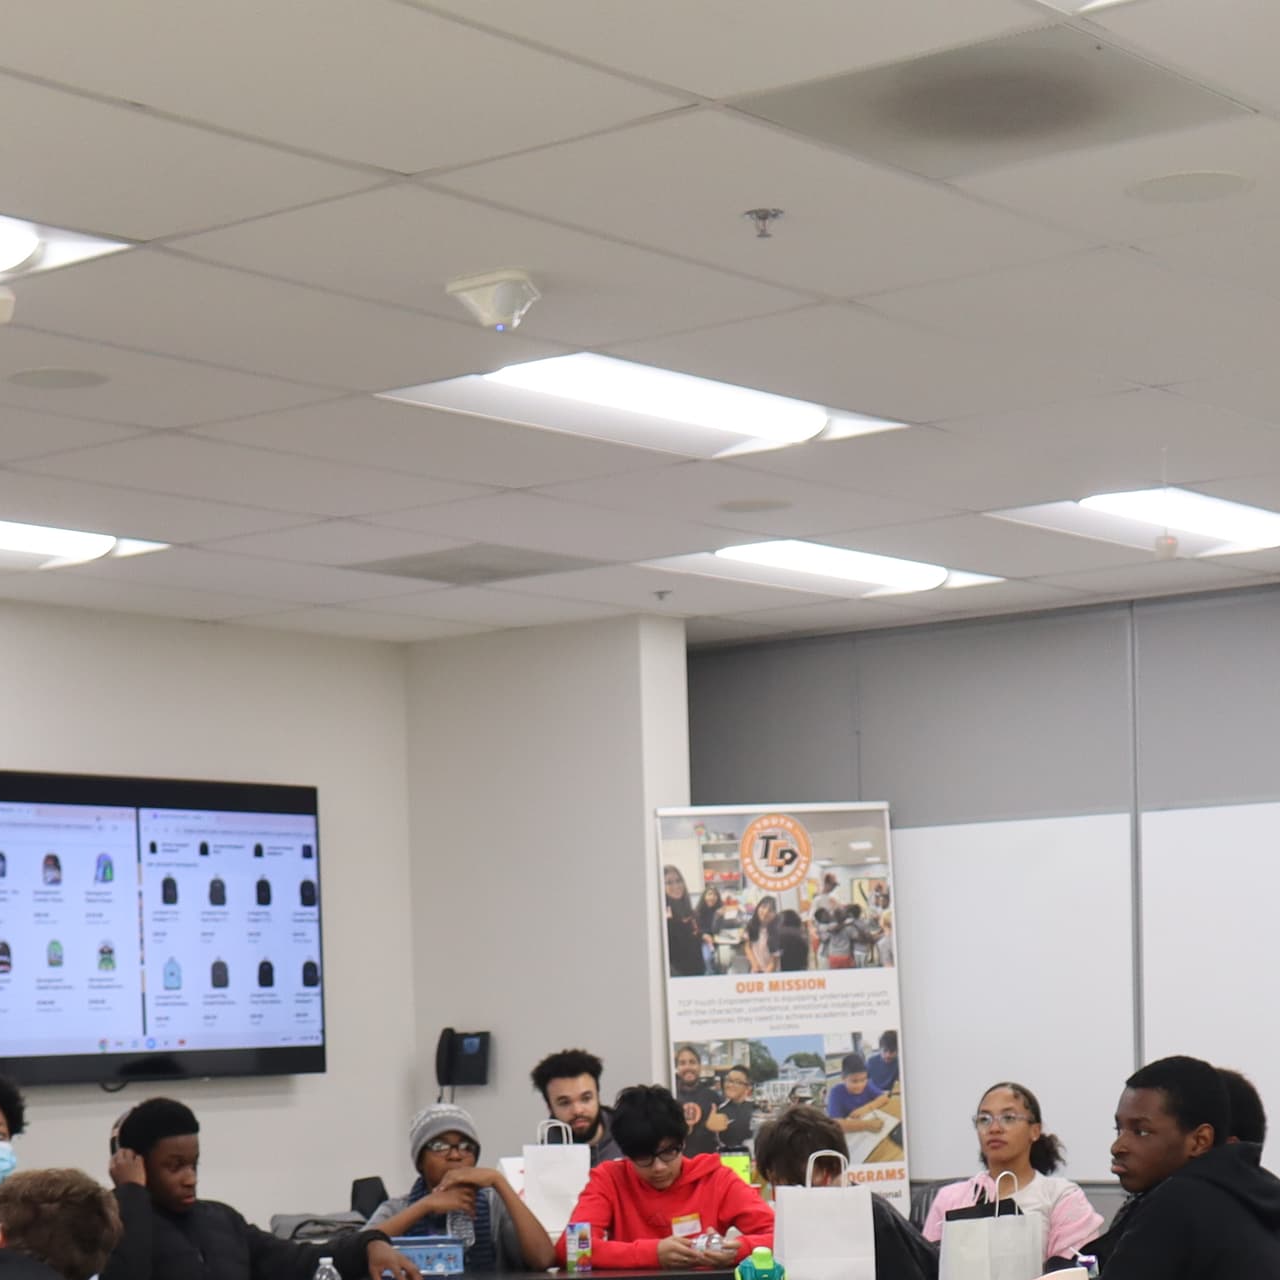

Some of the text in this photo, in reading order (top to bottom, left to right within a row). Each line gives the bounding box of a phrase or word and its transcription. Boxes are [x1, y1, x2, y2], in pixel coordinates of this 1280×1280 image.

[735, 978, 826, 993] OUR MISSION
[847, 1168, 906, 1183] OGRAMS
